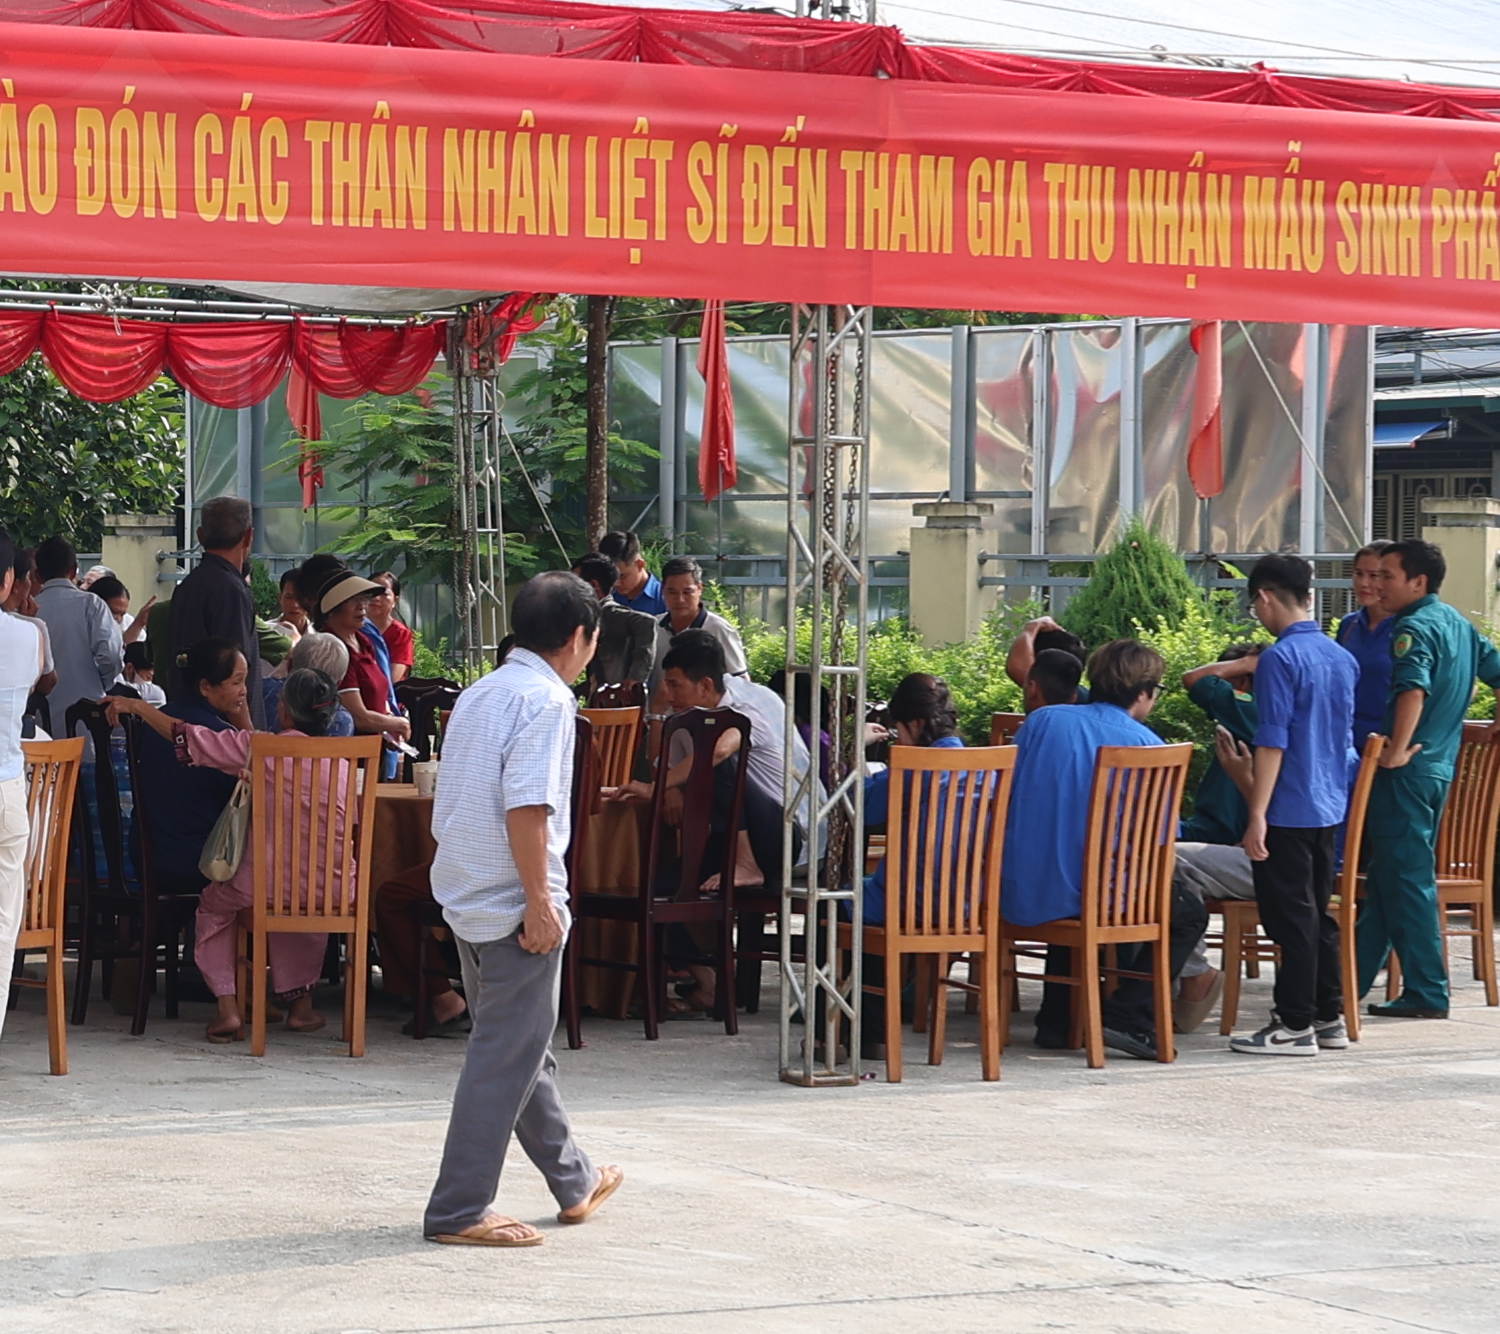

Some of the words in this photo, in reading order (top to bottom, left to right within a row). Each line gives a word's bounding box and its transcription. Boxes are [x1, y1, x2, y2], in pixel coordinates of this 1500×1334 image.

[73, 86, 178, 219] ĐÓN
[193, 93, 290, 225] CÁC
[304, 101, 428, 230] THÂN
[443, 110, 571, 237] NHÂN
[584, 117, 675, 265] LIỆT
[686, 124, 738, 244] SĨ
[741, 115, 828, 248] ĐẾN
[840, 150, 955, 254] THAM
[966, 156, 1033, 258] GIA
[1043, 162, 1116, 263] THU
[1126, 151, 1233, 289] NHẬN
[1242, 140, 1326, 273] MẪU
[1335, 180, 1422, 277] SINH
